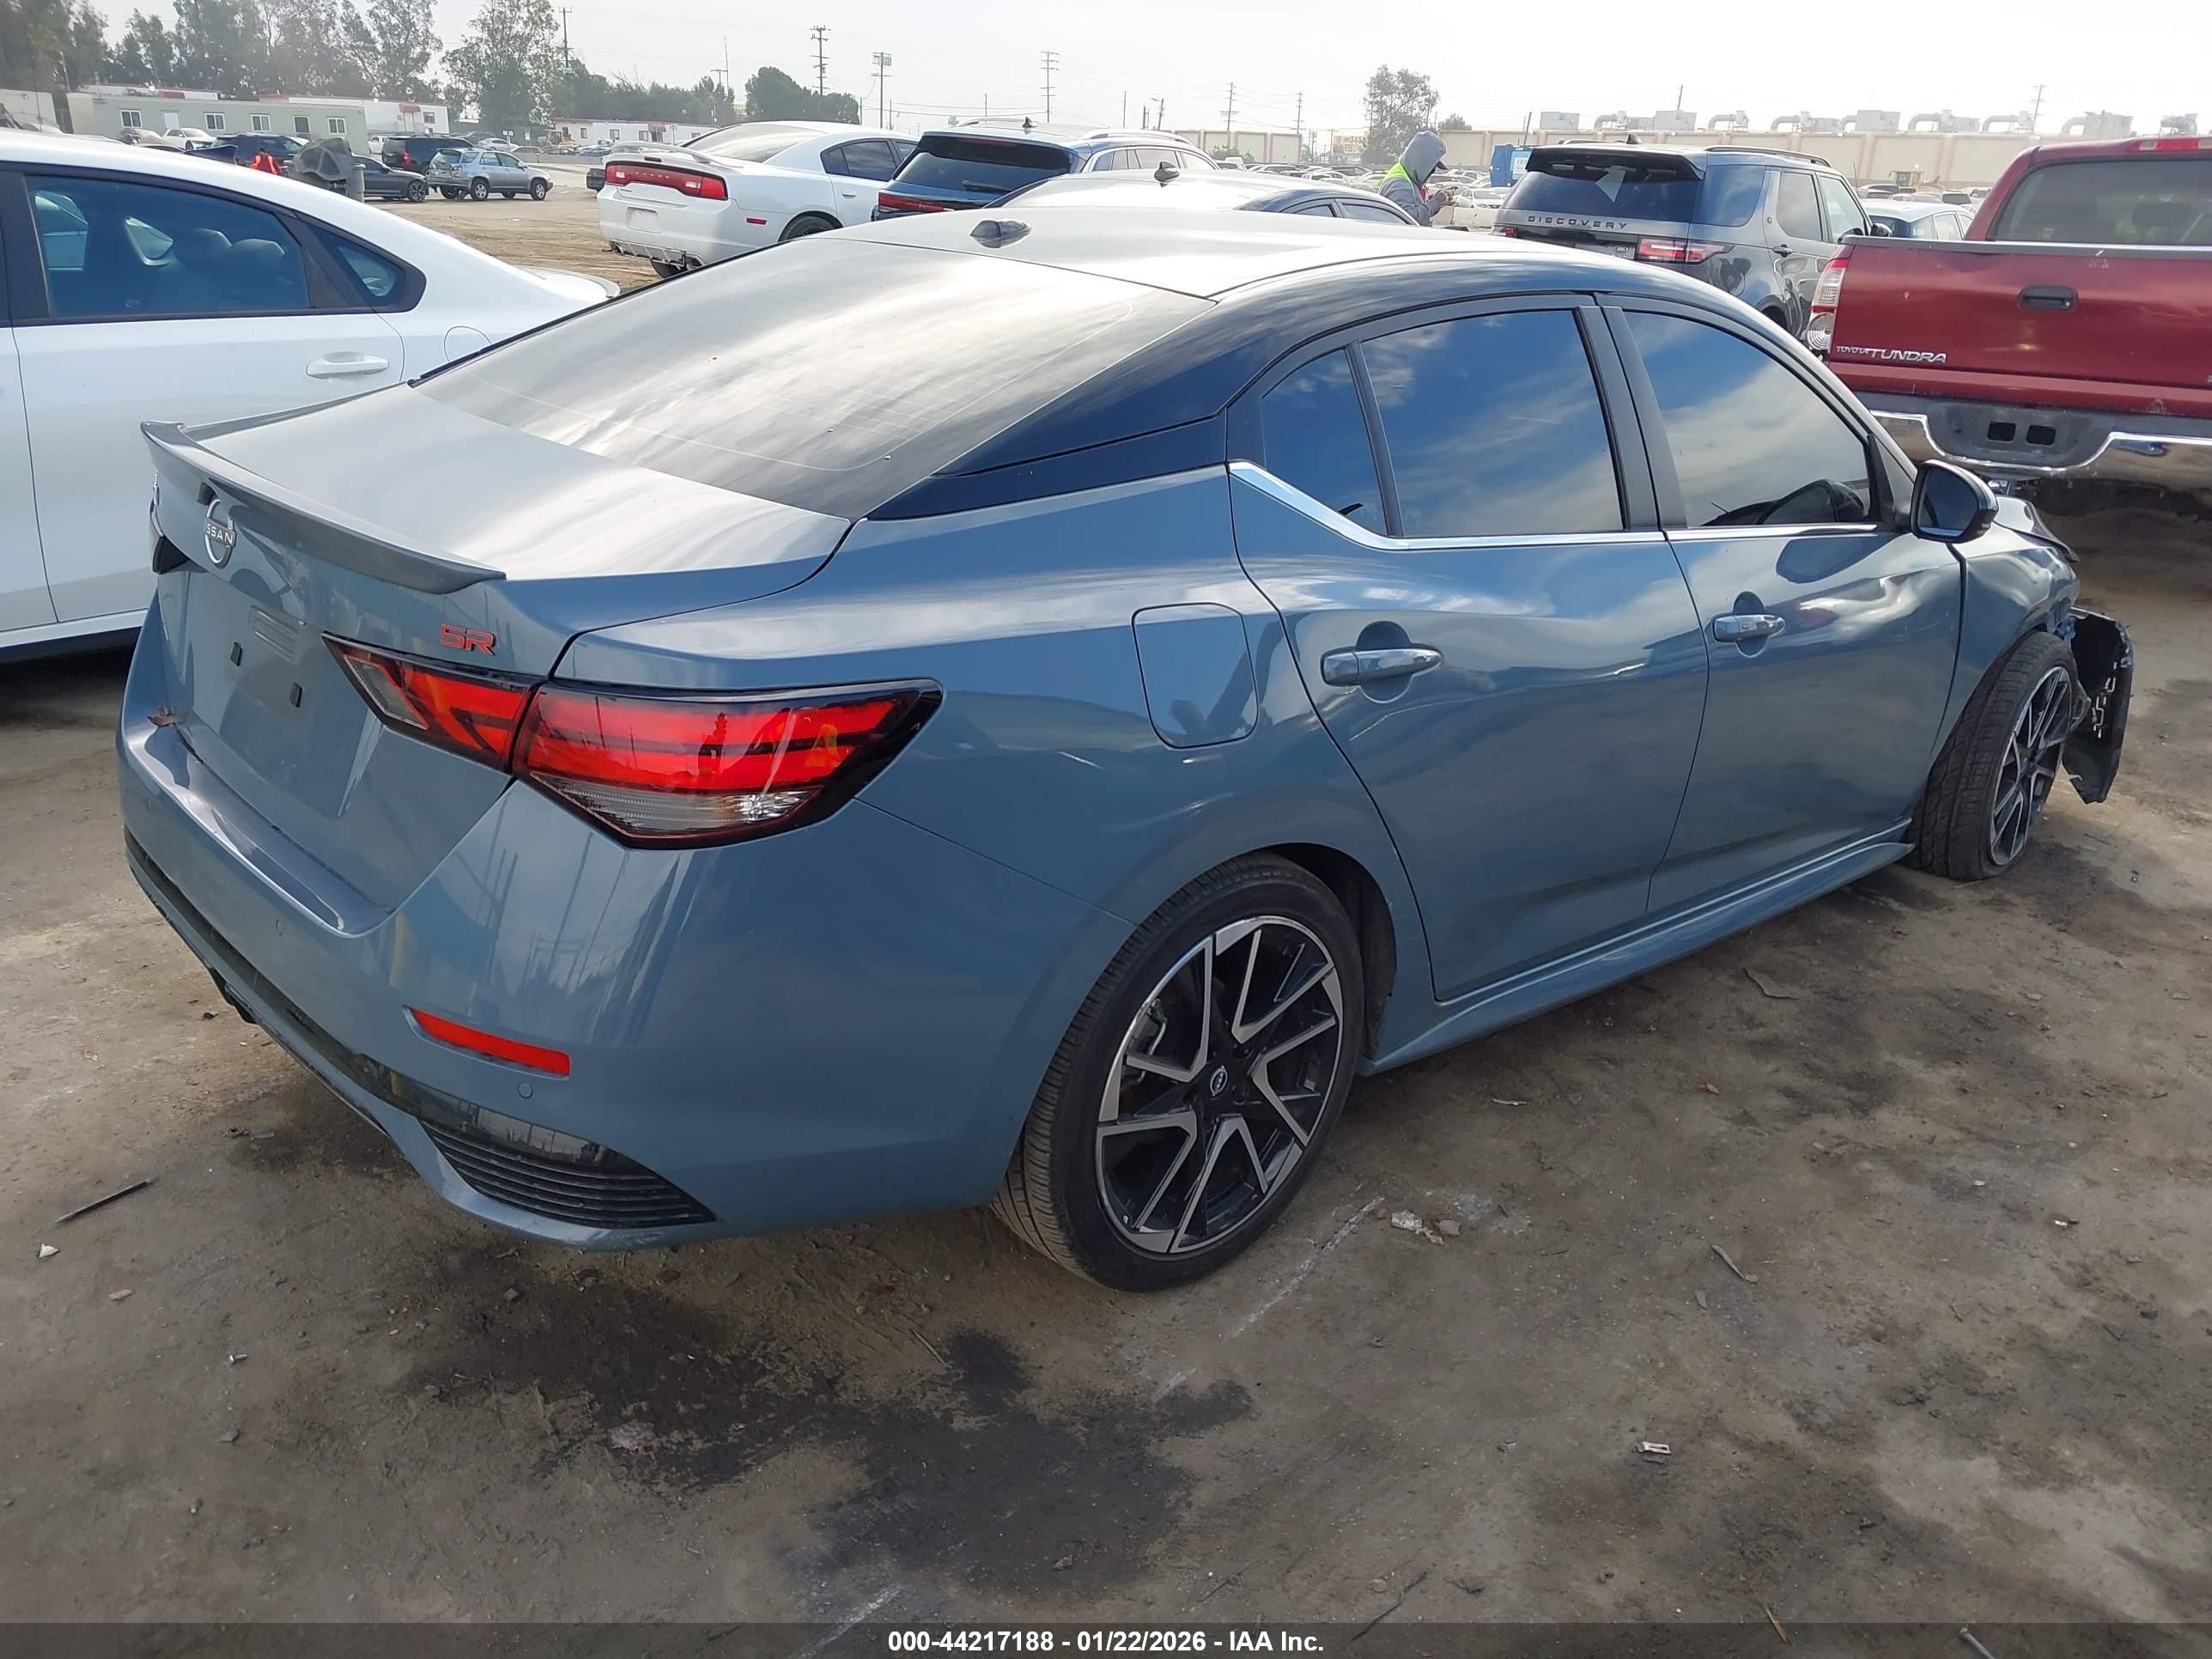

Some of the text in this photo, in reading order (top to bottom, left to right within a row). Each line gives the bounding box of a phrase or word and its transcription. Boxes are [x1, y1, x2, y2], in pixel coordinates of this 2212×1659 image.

[1527, 215, 1628, 230] DISCOVERY
[1836, 345, 1947, 363] TOYOTA TUNDRA
[206, 523, 234, 544] SSAN
[440, 623, 495, 656] SR
